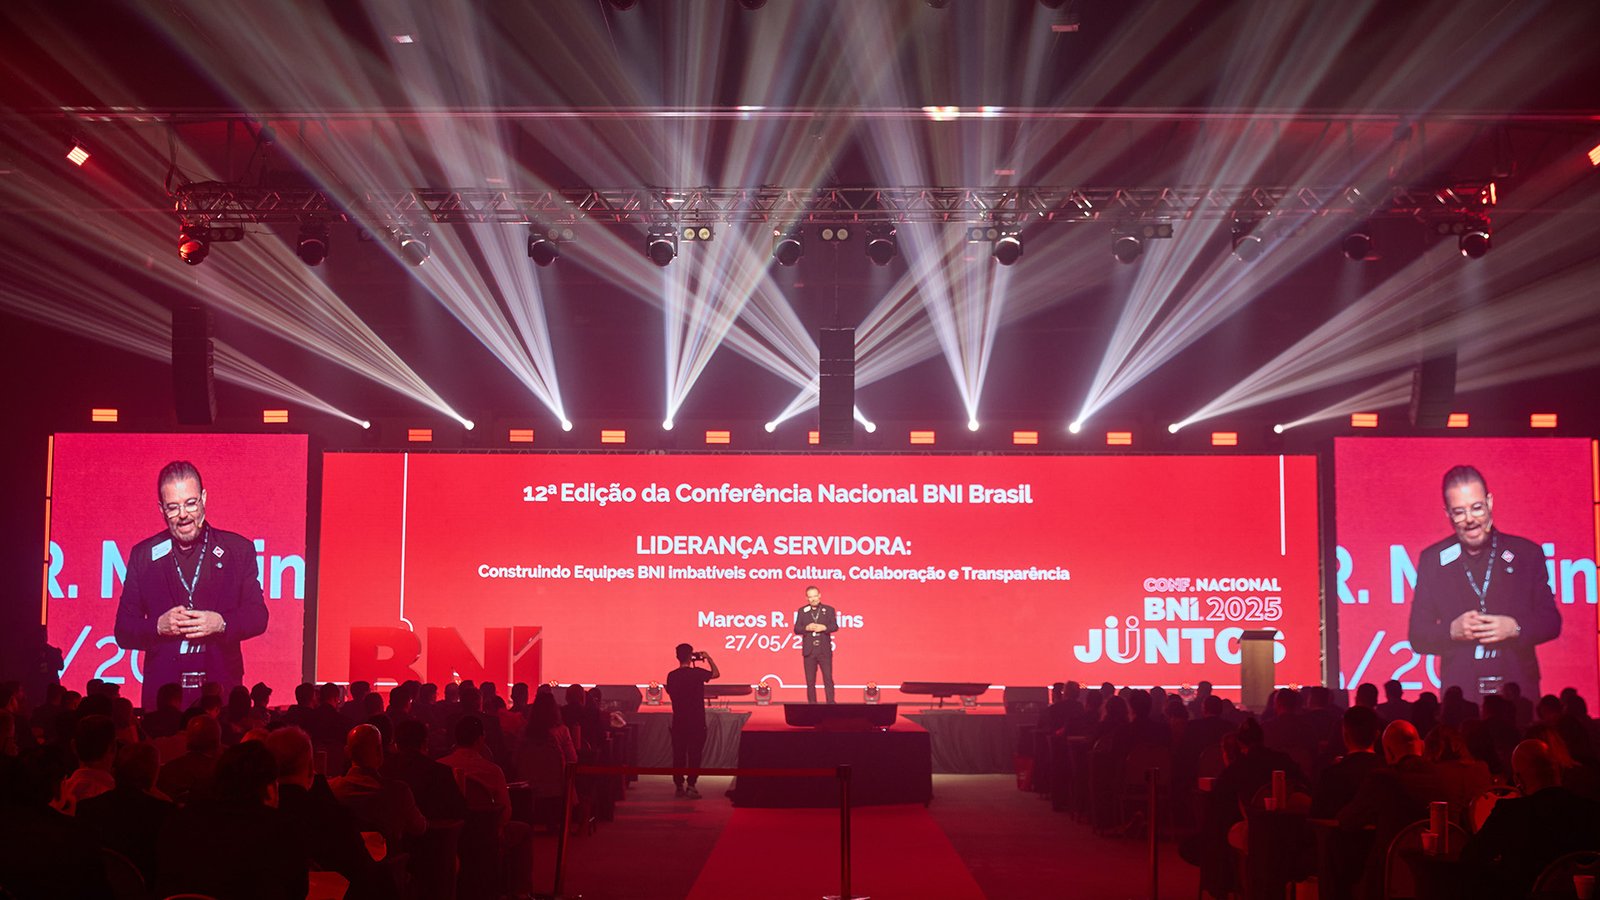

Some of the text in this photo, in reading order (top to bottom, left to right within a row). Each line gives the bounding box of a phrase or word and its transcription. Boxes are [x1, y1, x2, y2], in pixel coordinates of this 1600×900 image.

[561, 483, 637, 507] Edição
[641, 483, 670, 502] da
[675, 483, 813, 503] Conferência
[818, 484, 918, 503] Nacional
[923, 484, 963, 503] BNI
[969, 484, 1034, 504] Brasil
[636, 535, 912, 559] LIDERANÇA SERVIDORA:
[477, 564, 1071, 584] Construindo Equipes BNI imbatíveis com Cultura, Colaboração e Transparência
[698, 611, 767, 628] Marcos
[771, 611, 789, 628] R.
